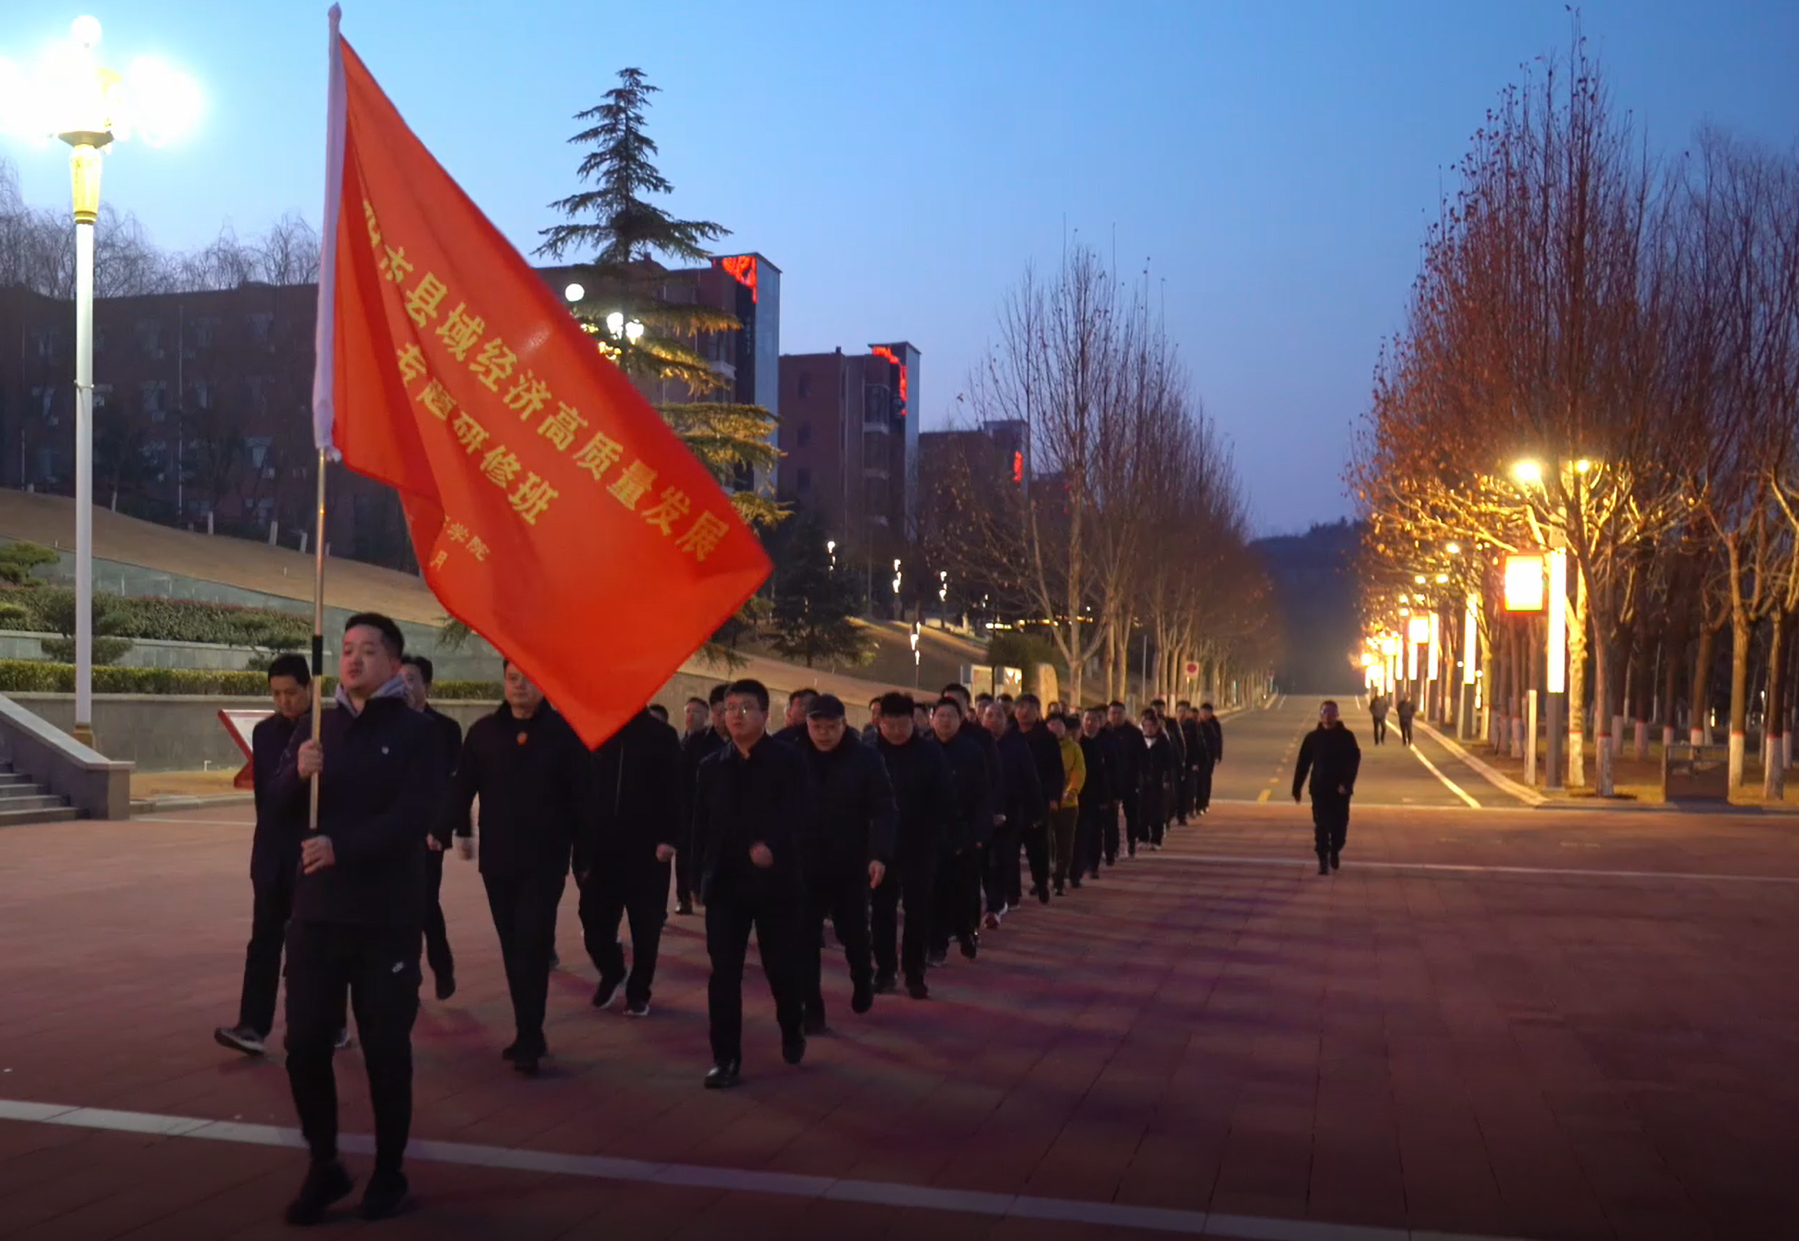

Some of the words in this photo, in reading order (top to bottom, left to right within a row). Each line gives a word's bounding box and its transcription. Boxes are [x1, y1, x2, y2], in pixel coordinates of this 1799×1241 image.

[397, 342, 559, 525] 专题研修班
[443, 514, 491, 562] 学院
